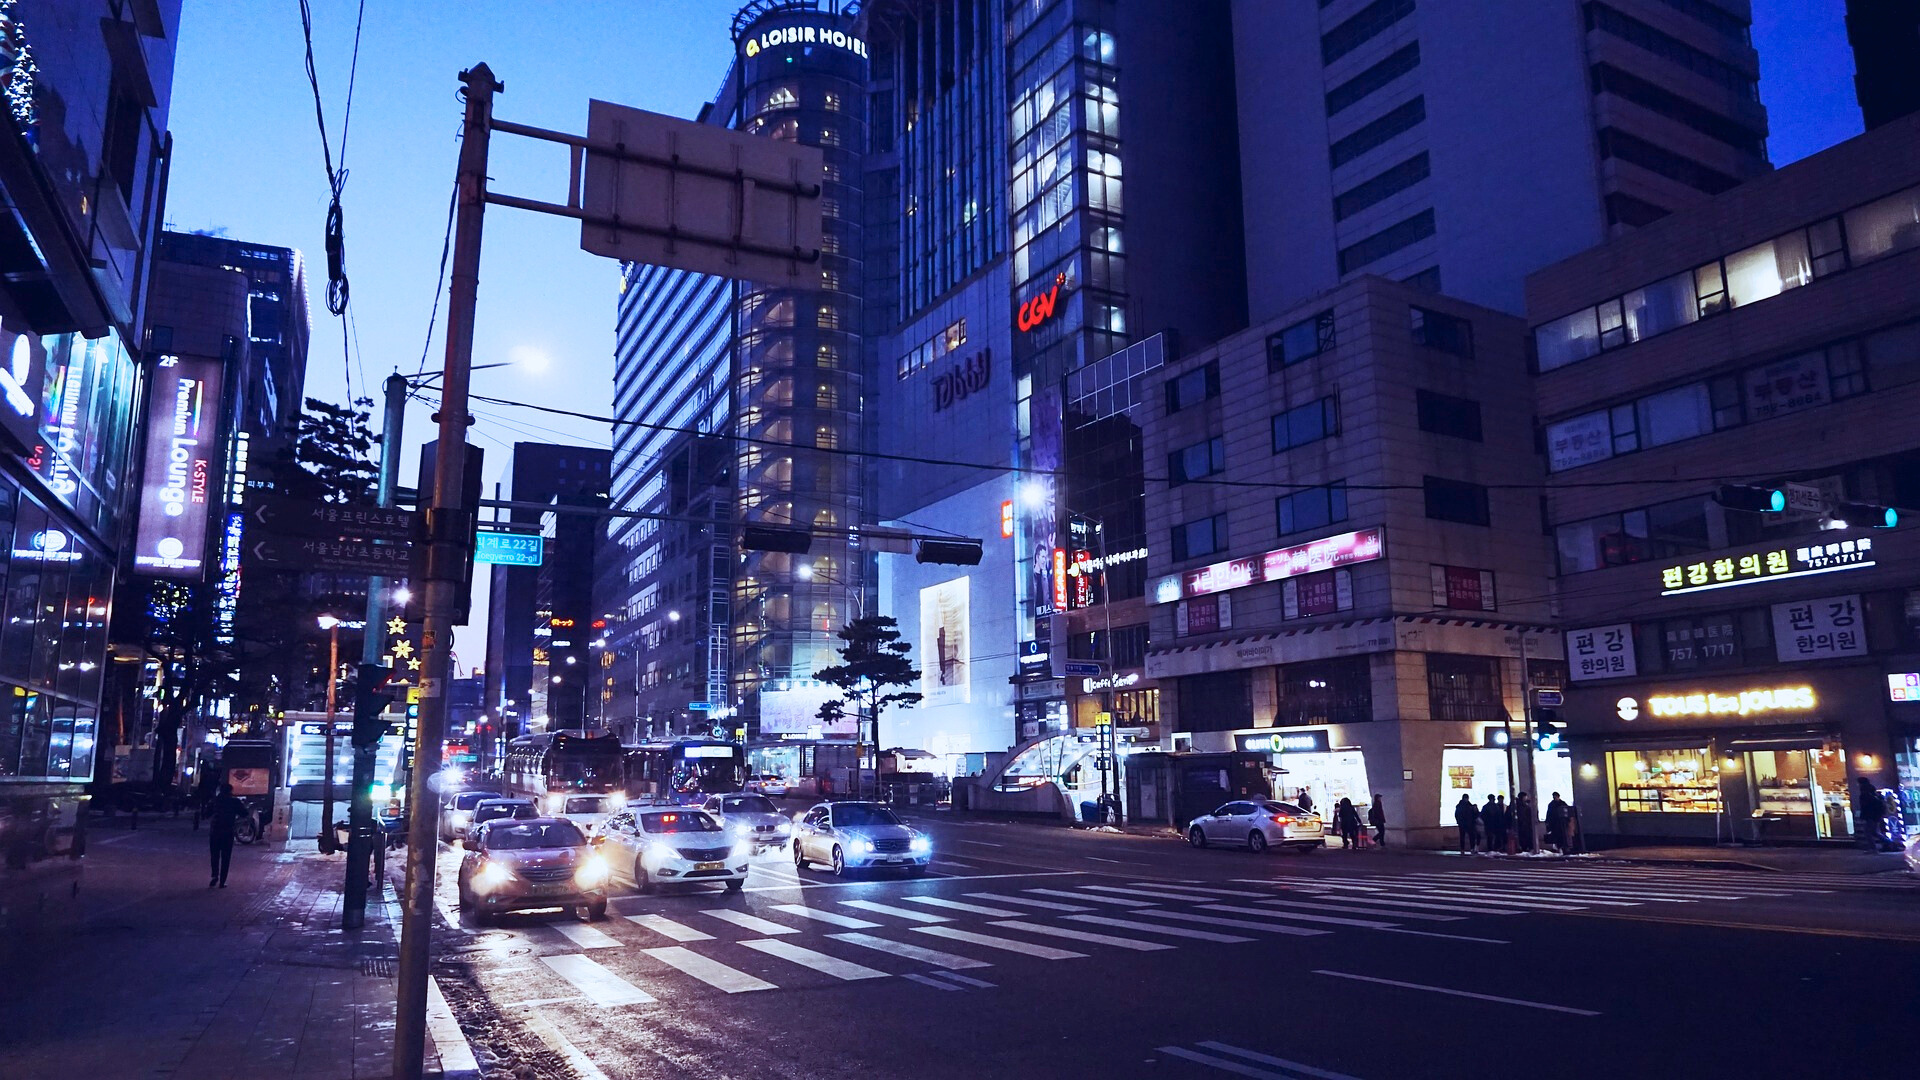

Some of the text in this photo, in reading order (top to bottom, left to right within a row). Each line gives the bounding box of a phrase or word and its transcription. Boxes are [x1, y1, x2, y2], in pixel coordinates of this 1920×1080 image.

[761, 26, 816, 49] LOISIR
[1017, 284, 1060, 332] CGV
[158, 355, 178, 367] 2F
[159, 378, 198, 517] Premium Lounge
[191, 459, 208, 504] K-STYLE
[311, 507, 410, 528] 서울프린스호텔
[303, 542, 410, 561] 서울남산초등학교
[1808, 552, 1864, 568] 757-1717
[1662, 549, 1789, 589] 편강한의원
[1702, 642, 1734, 657] 1717
[1796, 631, 1857, 654] 한의원
[1581, 655, 1626, 675] 한의원
[1648, 686, 1814, 716] TOUS les JOURS
